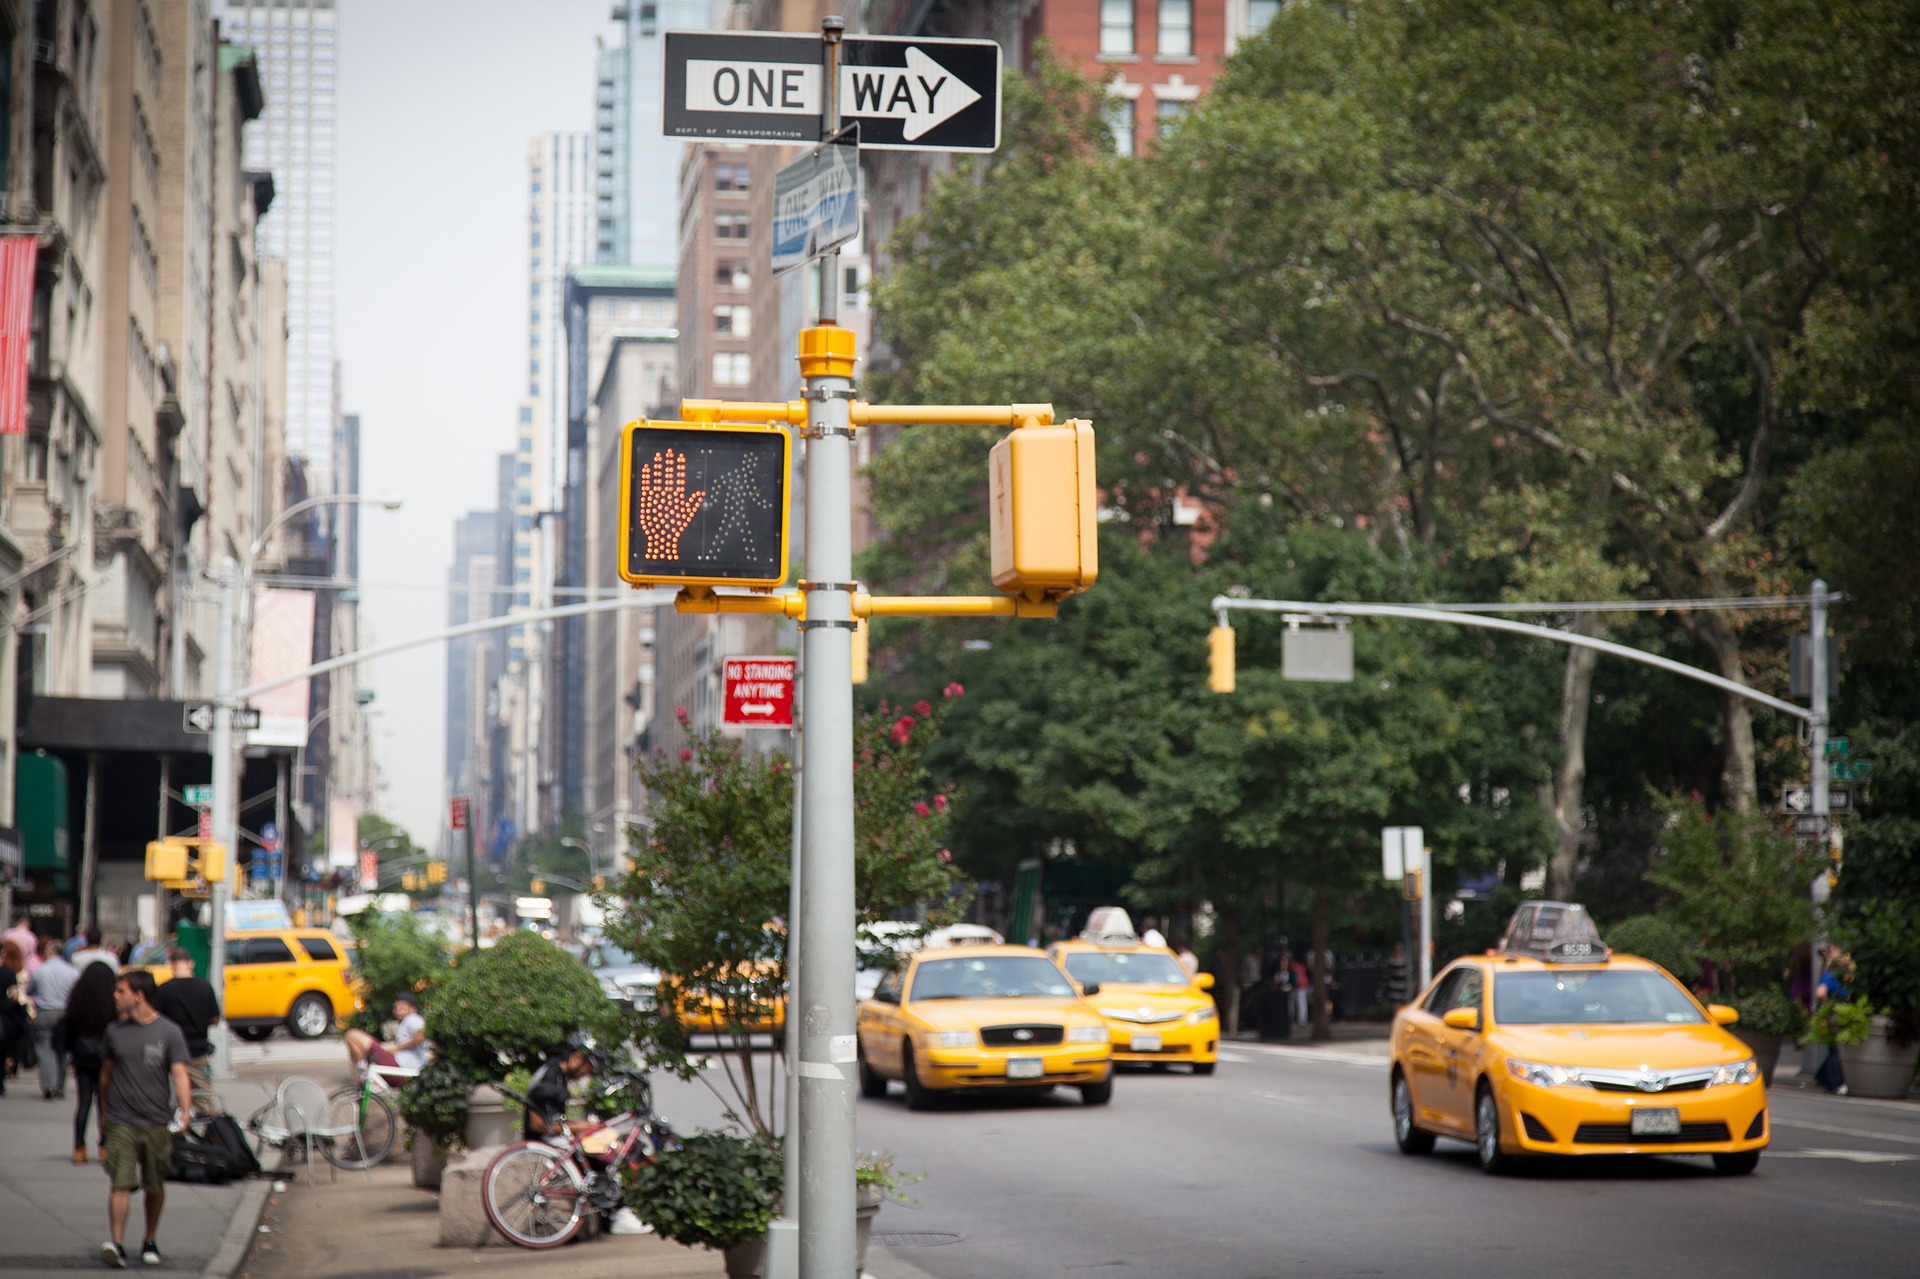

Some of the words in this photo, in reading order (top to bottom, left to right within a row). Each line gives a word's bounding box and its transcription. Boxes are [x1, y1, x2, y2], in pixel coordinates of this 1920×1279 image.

[713, 67, 804, 108] ONE
[852, 72, 947, 114] WAY
[726, 128, 802, 137] TRANSPORTATION
[784, 187, 809, 236] ONE
[819, 168, 845, 218] WAY
[728, 664, 743, 680] NO
[744, 664, 794, 681] STANDING
[733, 682, 785, 699] ANYTIME
